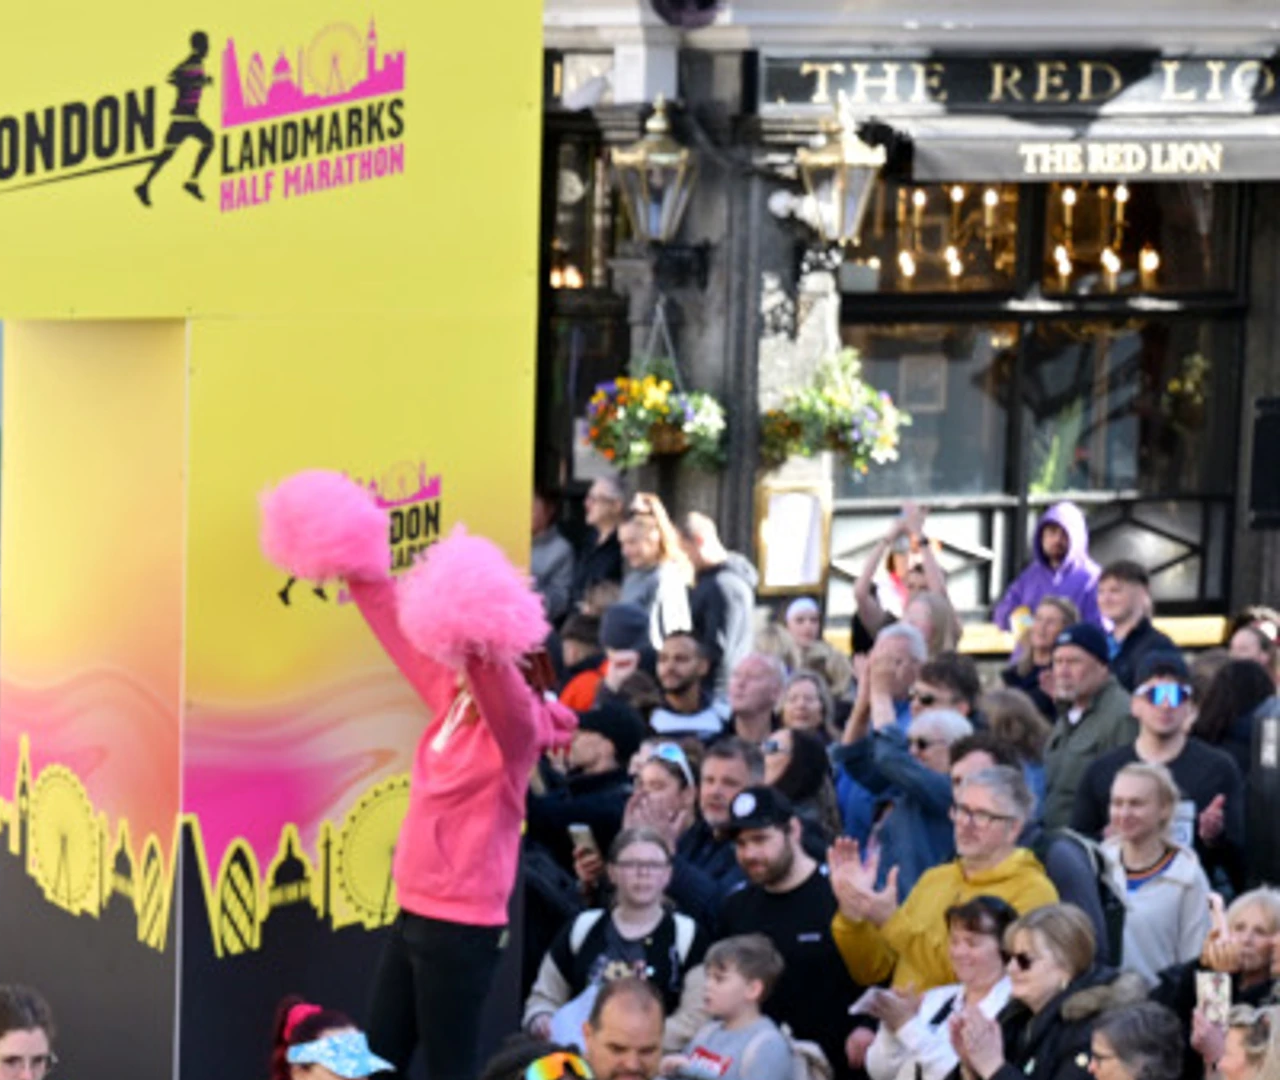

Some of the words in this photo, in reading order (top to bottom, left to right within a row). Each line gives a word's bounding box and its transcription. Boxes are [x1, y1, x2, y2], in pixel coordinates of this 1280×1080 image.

[799, 60, 948, 104] THE
[988, 61, 1124, 102] RED
[220, 98, 405, 176] LANDMARKS
[1019, 142, 1082, 174] THE
[1088, 142, 1147, 174] RED
[1149, 142, 1224, 174] LION
[219, 169, 274, 213] HALF
[283, 142, 405, 199] MARATHON
[388, 499, 440, 546] DON
